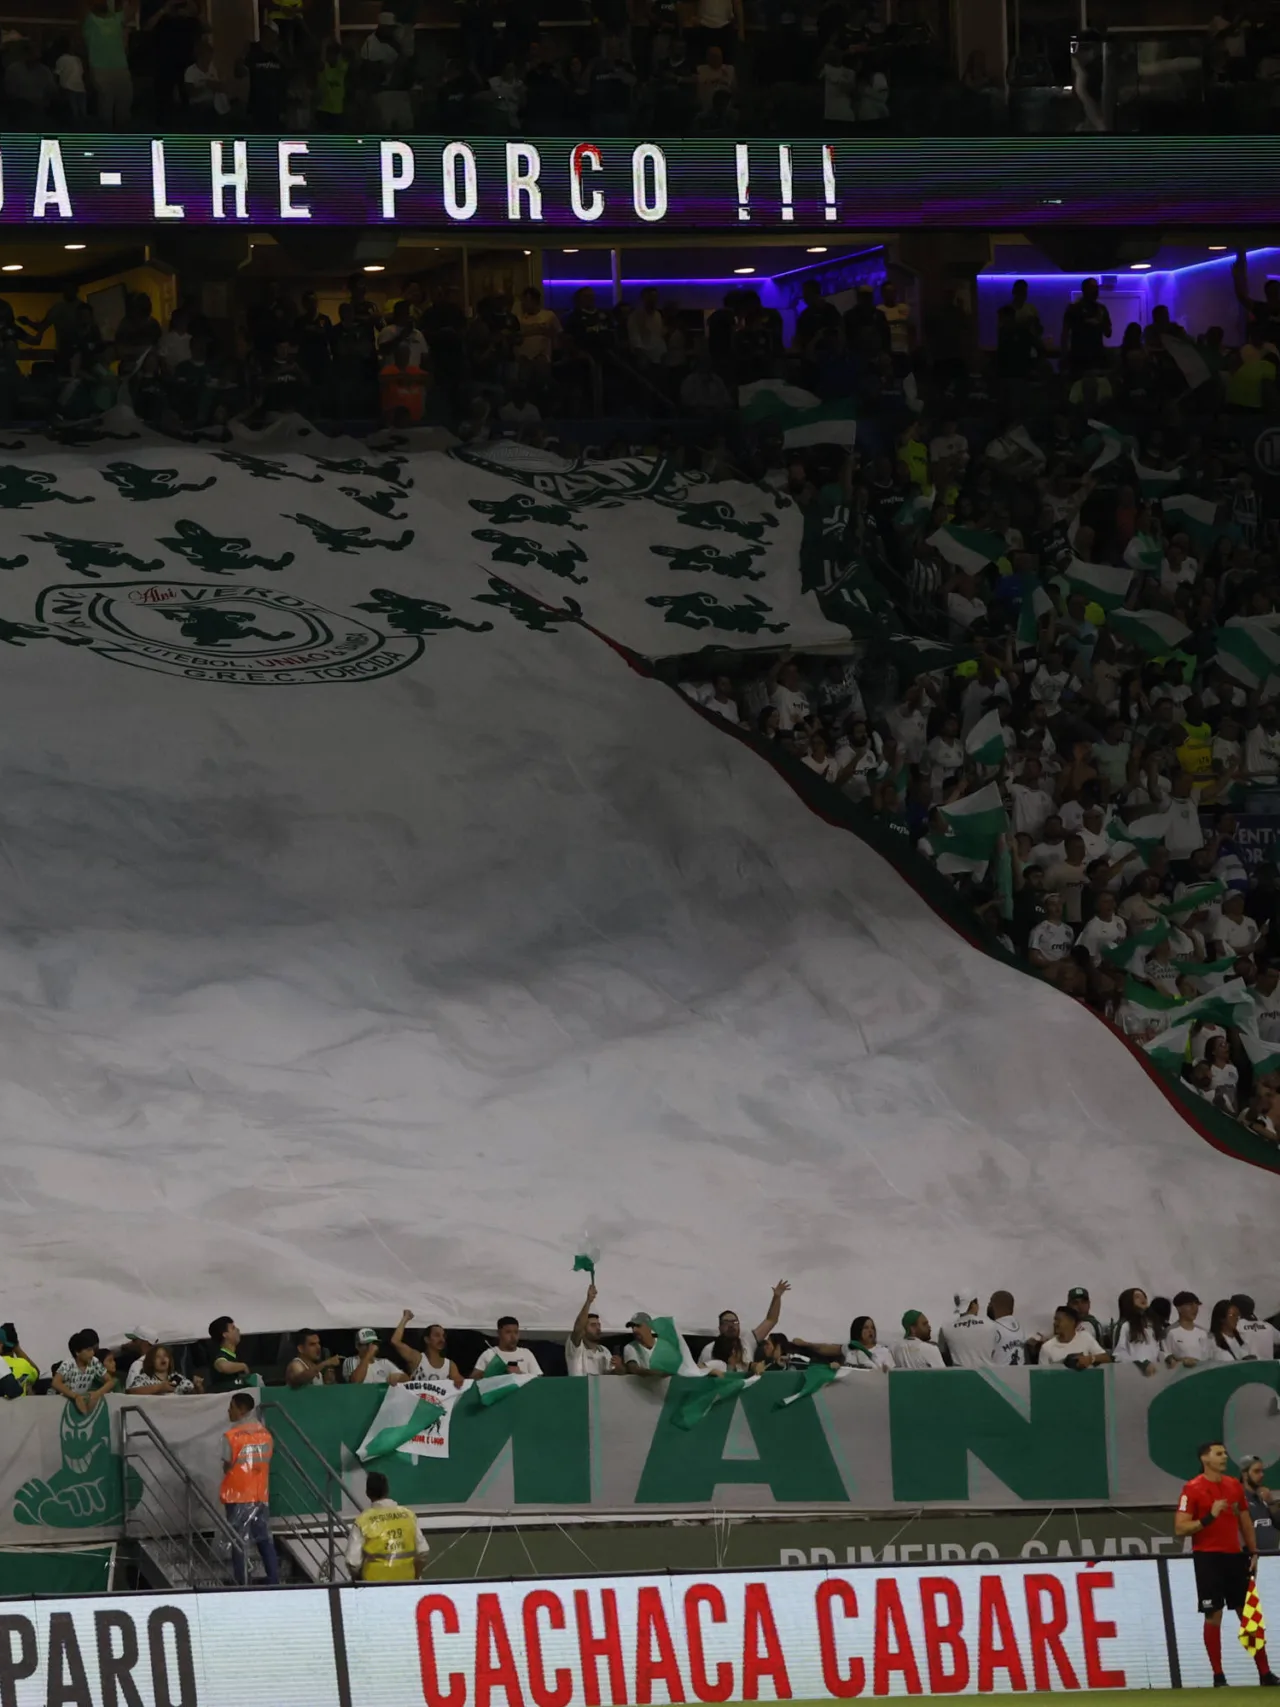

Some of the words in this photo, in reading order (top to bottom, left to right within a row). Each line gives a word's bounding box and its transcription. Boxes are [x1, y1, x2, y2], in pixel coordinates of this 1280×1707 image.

[380, 140, 668, 221] PORCO
[735, 143, 838, 221] !!!
[305, 651, 406, 681] TORCIDA
[815, 1562, 1126, 1698] CABARÉ
